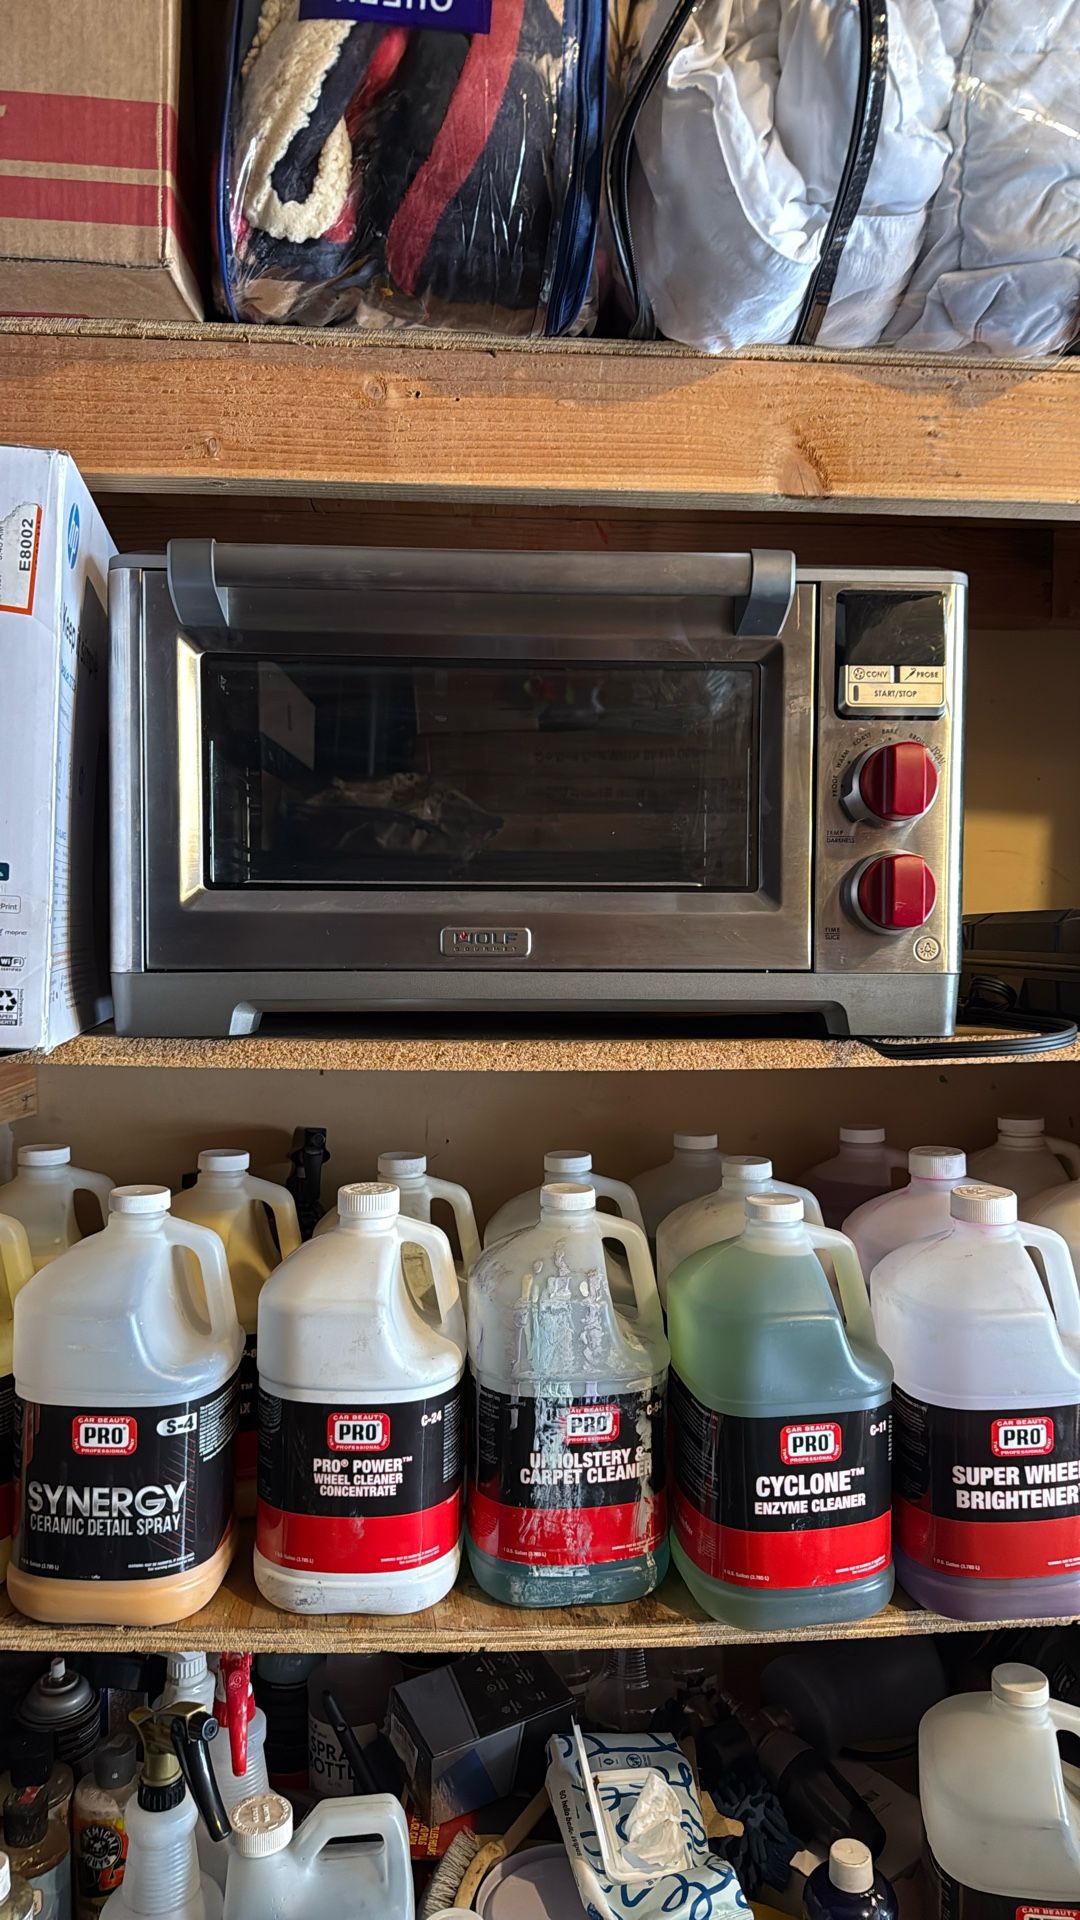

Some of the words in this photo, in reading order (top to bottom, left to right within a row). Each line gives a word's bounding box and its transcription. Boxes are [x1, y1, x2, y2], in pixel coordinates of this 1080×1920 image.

[18, 518, 34, 572] E8002
[866, 670, 888, 678] CONV
[874, 690, 918, 698] START/STOP
[836, 749, 850, 770] WARM
[0, 902, 17, 911] Print
[452, 931, 518, 945] WOLF
[166, 1415, 195, 1434] S-4
[421, 1410, 443, 1427] C-24
[571, 1415, 608, 1433] PRO
[84, 1426, 124, 1444] PRO
[339, 1423, 377, 1441] PRO
[805, 1424, 836, 1432] BEAUTY
[869, 1419, 888, 1437] C-11
[1003, 1428, 1041, 1446] PRO
[792, 1434, 829, 1453] PRO
[313, 1473, 351, 1486] WHEEL
[353, 1473, 404, 1486] CLEANER
[520, 1467, 583, 1485] CARPET
[586, 1461, 652, 1484] CLEANER
[952, 1465, 1021, 1487] SUPER
[27, 1479, 187, 1518] SYNERGY
[319, 1484, 397, 1497] CONCENTRATE
[955, 1484, 1080, 1510] BRIGHTENER
[754, 1498, 809, 1516] ENZYME
[811, 1492, 867, 1513] CLEANER
[29, 1513, 85, 1536] CERAMIC
[87, 1518, 134, 1537] DETAIL
[136, 1512, 181, 1535] SPRAY
[310, 1735, 350, 1763] SPRA
[310, 1752, 354, 1780] OTTL
[561, 1800, 571, 1817] hello
[1042, 1908, 1079, 1917] BEAUTY
